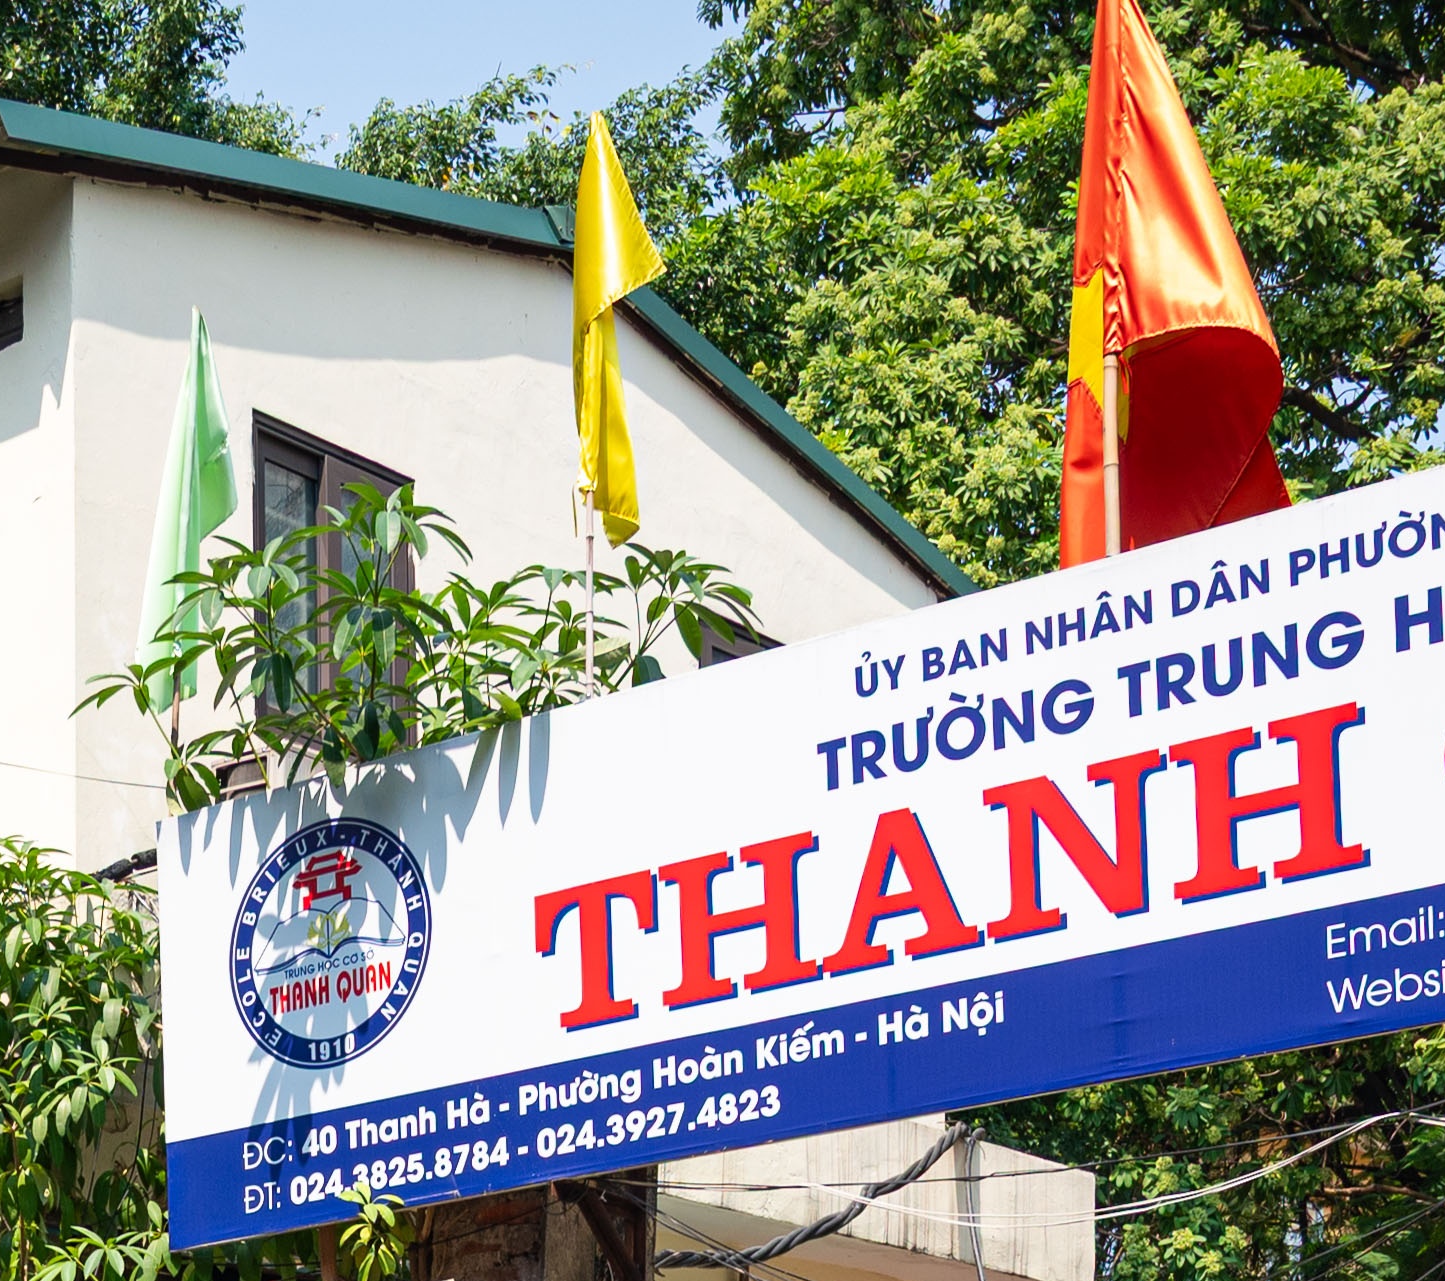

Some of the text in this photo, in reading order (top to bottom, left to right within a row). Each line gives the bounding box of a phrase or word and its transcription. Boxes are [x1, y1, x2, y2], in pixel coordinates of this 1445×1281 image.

[855, 649, 905, 698] ỦY
[923, 629, 1004, 680] BAN
[1025, 593, 1151, 663] NHÂN
[1172, 557, 1268, 625] DÂN
[818, 682, 1093, 789] TRƯỜNG
[1130, 608, 1363, 718] TRUNG
[242, 830, 328, 926] BRIEUX
[359, 829, 423, 911] THANH
[533, 703, 1367, 1031] THANH
[269, 961, 391, 1016] THANH QUAN
[284, 964, 315, 980] TRUNG
[317, 960, 339, 972] HỌC
[343, 954, 358, 965] CƠ
[380, 931, 424, 1023] QUAN
[242, 1138, 293, 1171] ĐC:
[303, 1124, 336, 1157] 40
[347, 1104, 436, 1155] Thanh
[448, 1092, 492, 1127] Hà
[519, 1061, 642, 1120] Phường
[653, 1041, 744, 1086] Hoàn
[754, 1021, 844, 1069] Kiếm
[878, 1010, 929, 1049] Hà
[941, 990, 1005, 1039] Nội
[308, 1033, 356, 1061] 1910
[242, 1177, 282, 1214] ĐT:
[289, 1134, 510, 1205] 024.3825.8784
[537, 1086, 782, 1160] 024.3927.4823
